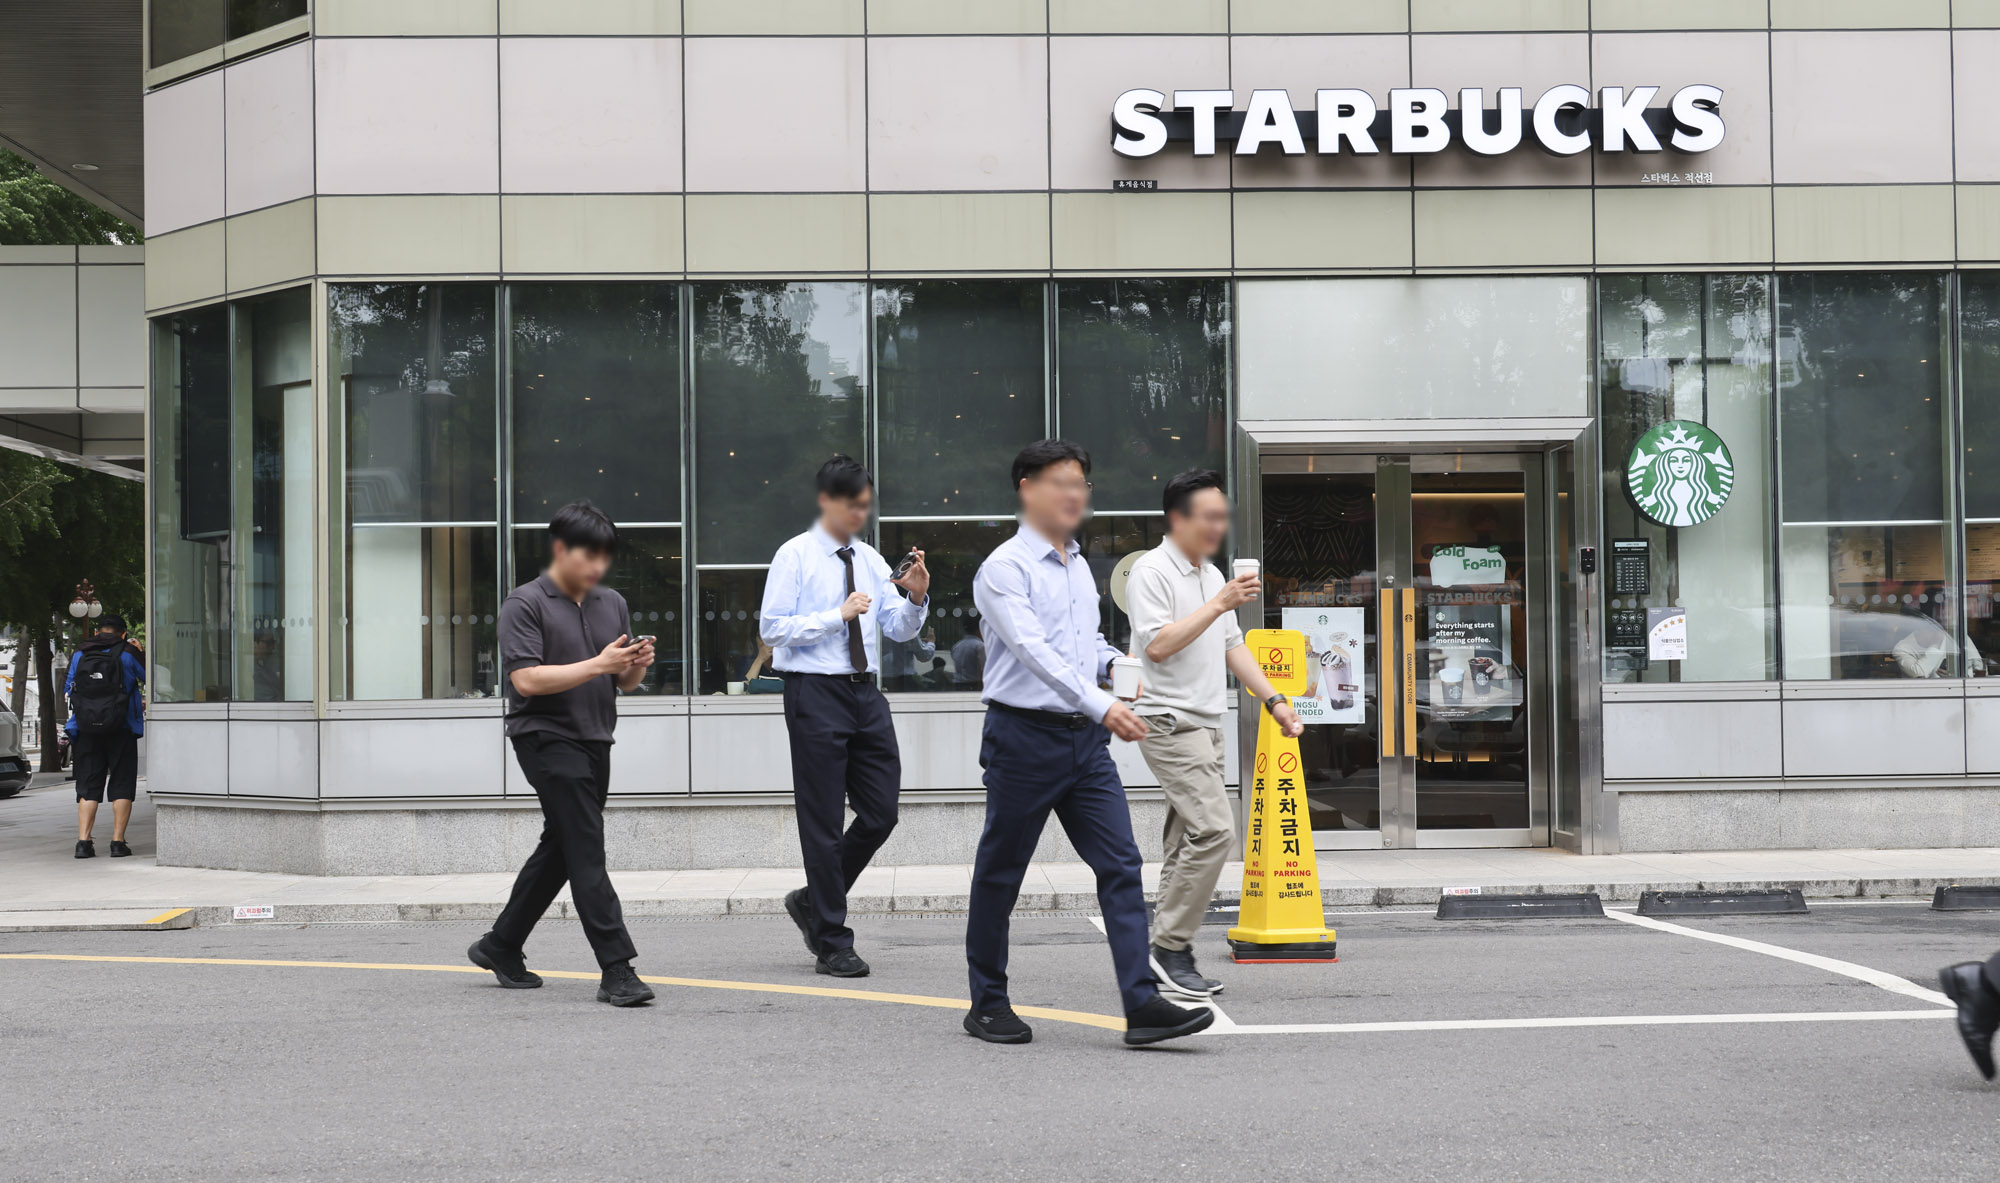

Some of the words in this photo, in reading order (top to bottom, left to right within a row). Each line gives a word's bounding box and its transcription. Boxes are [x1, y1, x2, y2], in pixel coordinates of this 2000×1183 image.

[1111, 84, 1726, 156] STARBUCKS
[1641, 172, 1680, 184] 스타벅스
[1684, 172, 1713, 184] 적선점
[1118, 180, 1153, 189] 휴게음식점
[1432, 544, 1466, 557] Cold
[1462, 558, 1502, 570] Foam
[1278, 593, 1363, 605] STARBUCKS
[1427, 591, 1512, 603] STARBUCKS
[1435, 622, 1473, 630] Everything
[1435, 629, 1453, 637] after
[1435, 637, 1466, 645] morning
[1251, 778, 1264, 856] 주차금지
[1277, 778, 1300, 856] 주차금지
[1252, 860, 1259, 868] NO
[1245, 869, 1265, 877] PARKING
[1286, 882, 1304, 890] 협조에
[1278, 890, 1313, 899] 감사드립니다
